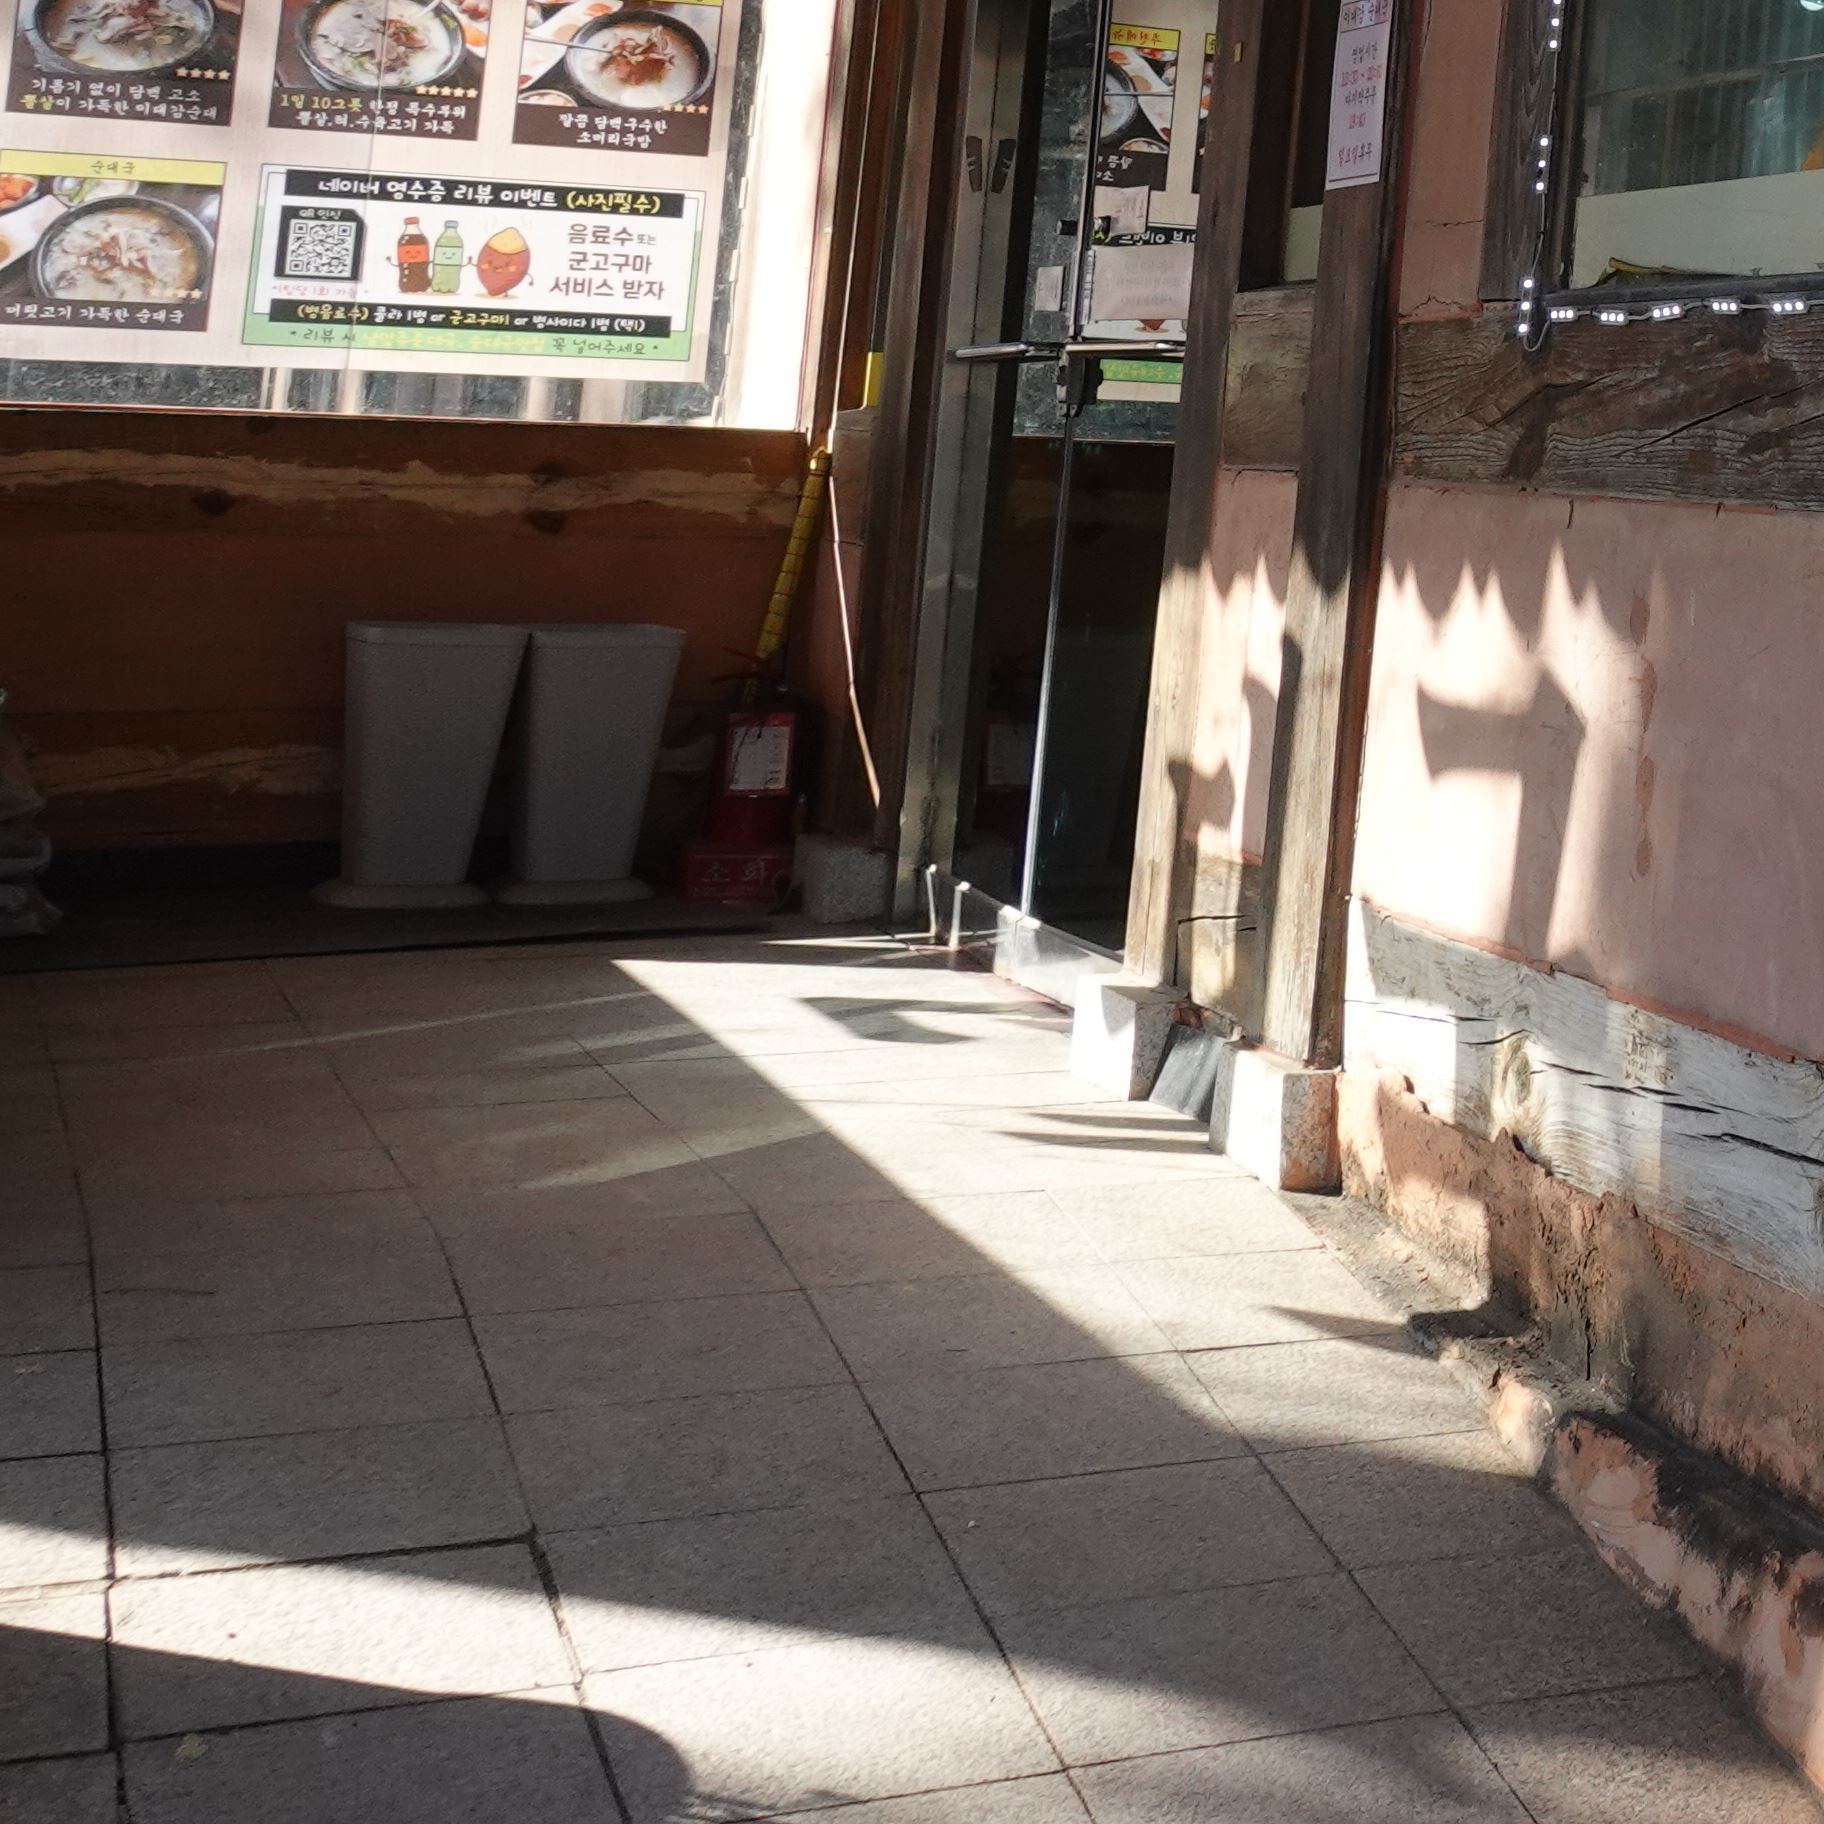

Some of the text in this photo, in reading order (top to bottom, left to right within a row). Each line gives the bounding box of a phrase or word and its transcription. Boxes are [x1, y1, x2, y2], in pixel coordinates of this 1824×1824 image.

[89, 81, 122, 98] 없이
[129, 84, 163, 100] 담백
[168, 87, 201, 103] 고소
[79, 97, 130, 116] 가득한
[135, 102, 218, 121] 이대감순대
[279, 94, 467, 119] 1일 10그릇 한정 특수부위
[423, 120, 455, 135] 가득
[576, 131, 652, 149] 소머리국밥
[90, 159, 136, 176] 순대국
[318, 177, 662, 214] 네이버 영수증 리뷰 이벤트 (사진필수)
[298, 208, 316, 218] QR
[567, 223, 657, 247] 음료수 또는
[568, 251, 653, 275] 군고구마
[549, 276, 666, 301] 서비스 받자
[5, 303, 186, 325] 머릿고기 가득한 순대국
[296, 304, 370, 321] (병음료수)
[373, 306, 403, 323] 콜라
[430, 313, 446, 322] or
[513, 317, 529, 326] or
[532, 316, 587, 329] 병사이다
[303, 328, 335, 343] 리뷰
[552, 337, 566, 352] 꼭
[572, 338, 647, 355] 넣어주세요
